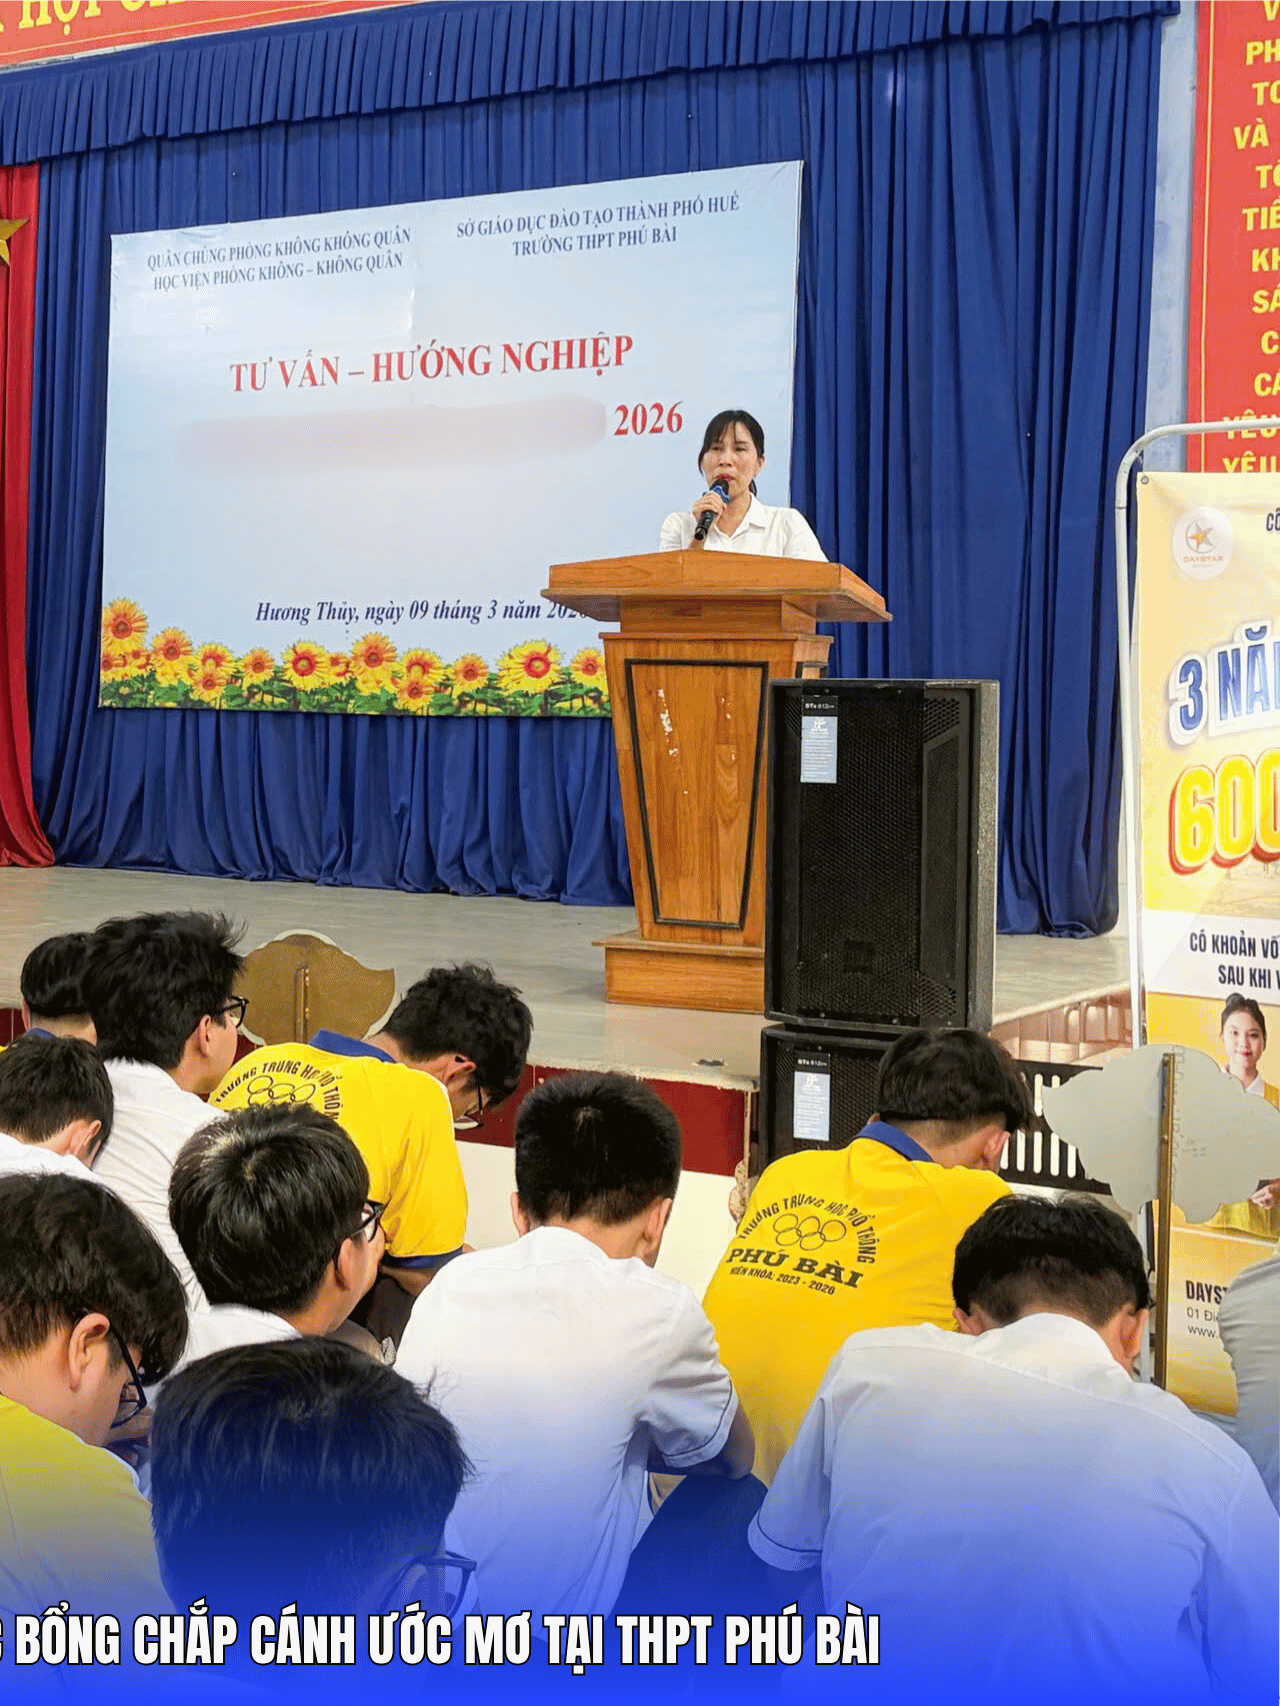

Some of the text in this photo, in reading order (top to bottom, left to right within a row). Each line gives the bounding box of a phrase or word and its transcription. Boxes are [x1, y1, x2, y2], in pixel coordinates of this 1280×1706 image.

[1233, 117, 1270, 150] VÀ
[477, 212, 513, 236] GIÁO
[516, 214, 546, 235] DỤC
[549, 207, 580, 230] ĐÀO
[583, 207, 614, 228] TẠO
[616, 199, 669, 222] THÀNH
[707, 189, 740, 213] HUẾ
[148, 248, 181, 272] QUÂN
[229, 241, 272, 263] PHÒNG
[275, 235, 320, 257] KHÔNG
[324, 230, 370, 251] KHÔNG
[373, 225, 413, 248] QUÂN
[512, 222, 678, 256] TRƯỜNG THPT PHÚ BÀI
[154, 272, 179, 294] HỌC
[213, 264, 256, 286] PHÒNG
[258, 260, 304, 281] KHÔNG
[316, 255, 363, 276] KHÔNG
[365, 249, 403, 272] QUÂN
[230, 331, 634, 392] TƯ VẤN HƯỚNG NGHIỆP
[613, 401, 684, 436] 2026
[255, 599, 541, 626] Hương Thủy, ngày 09 tháng 3 năm
[1179, 625, 1280, 731] 3 NĂ
[1190, 928, 1257, 958] CÓ KHOẢN
[1218, 964, 1245, 987] SAU
[1249, 966, 1271, 990] KHI
[726, 1248, 864, 1289] PHÚ BÀI
[776, 1272, 801, 1286] 2023
[807, 1279, 837, 1296] 2026
[1186, 1306, 1199, 1320] 01
